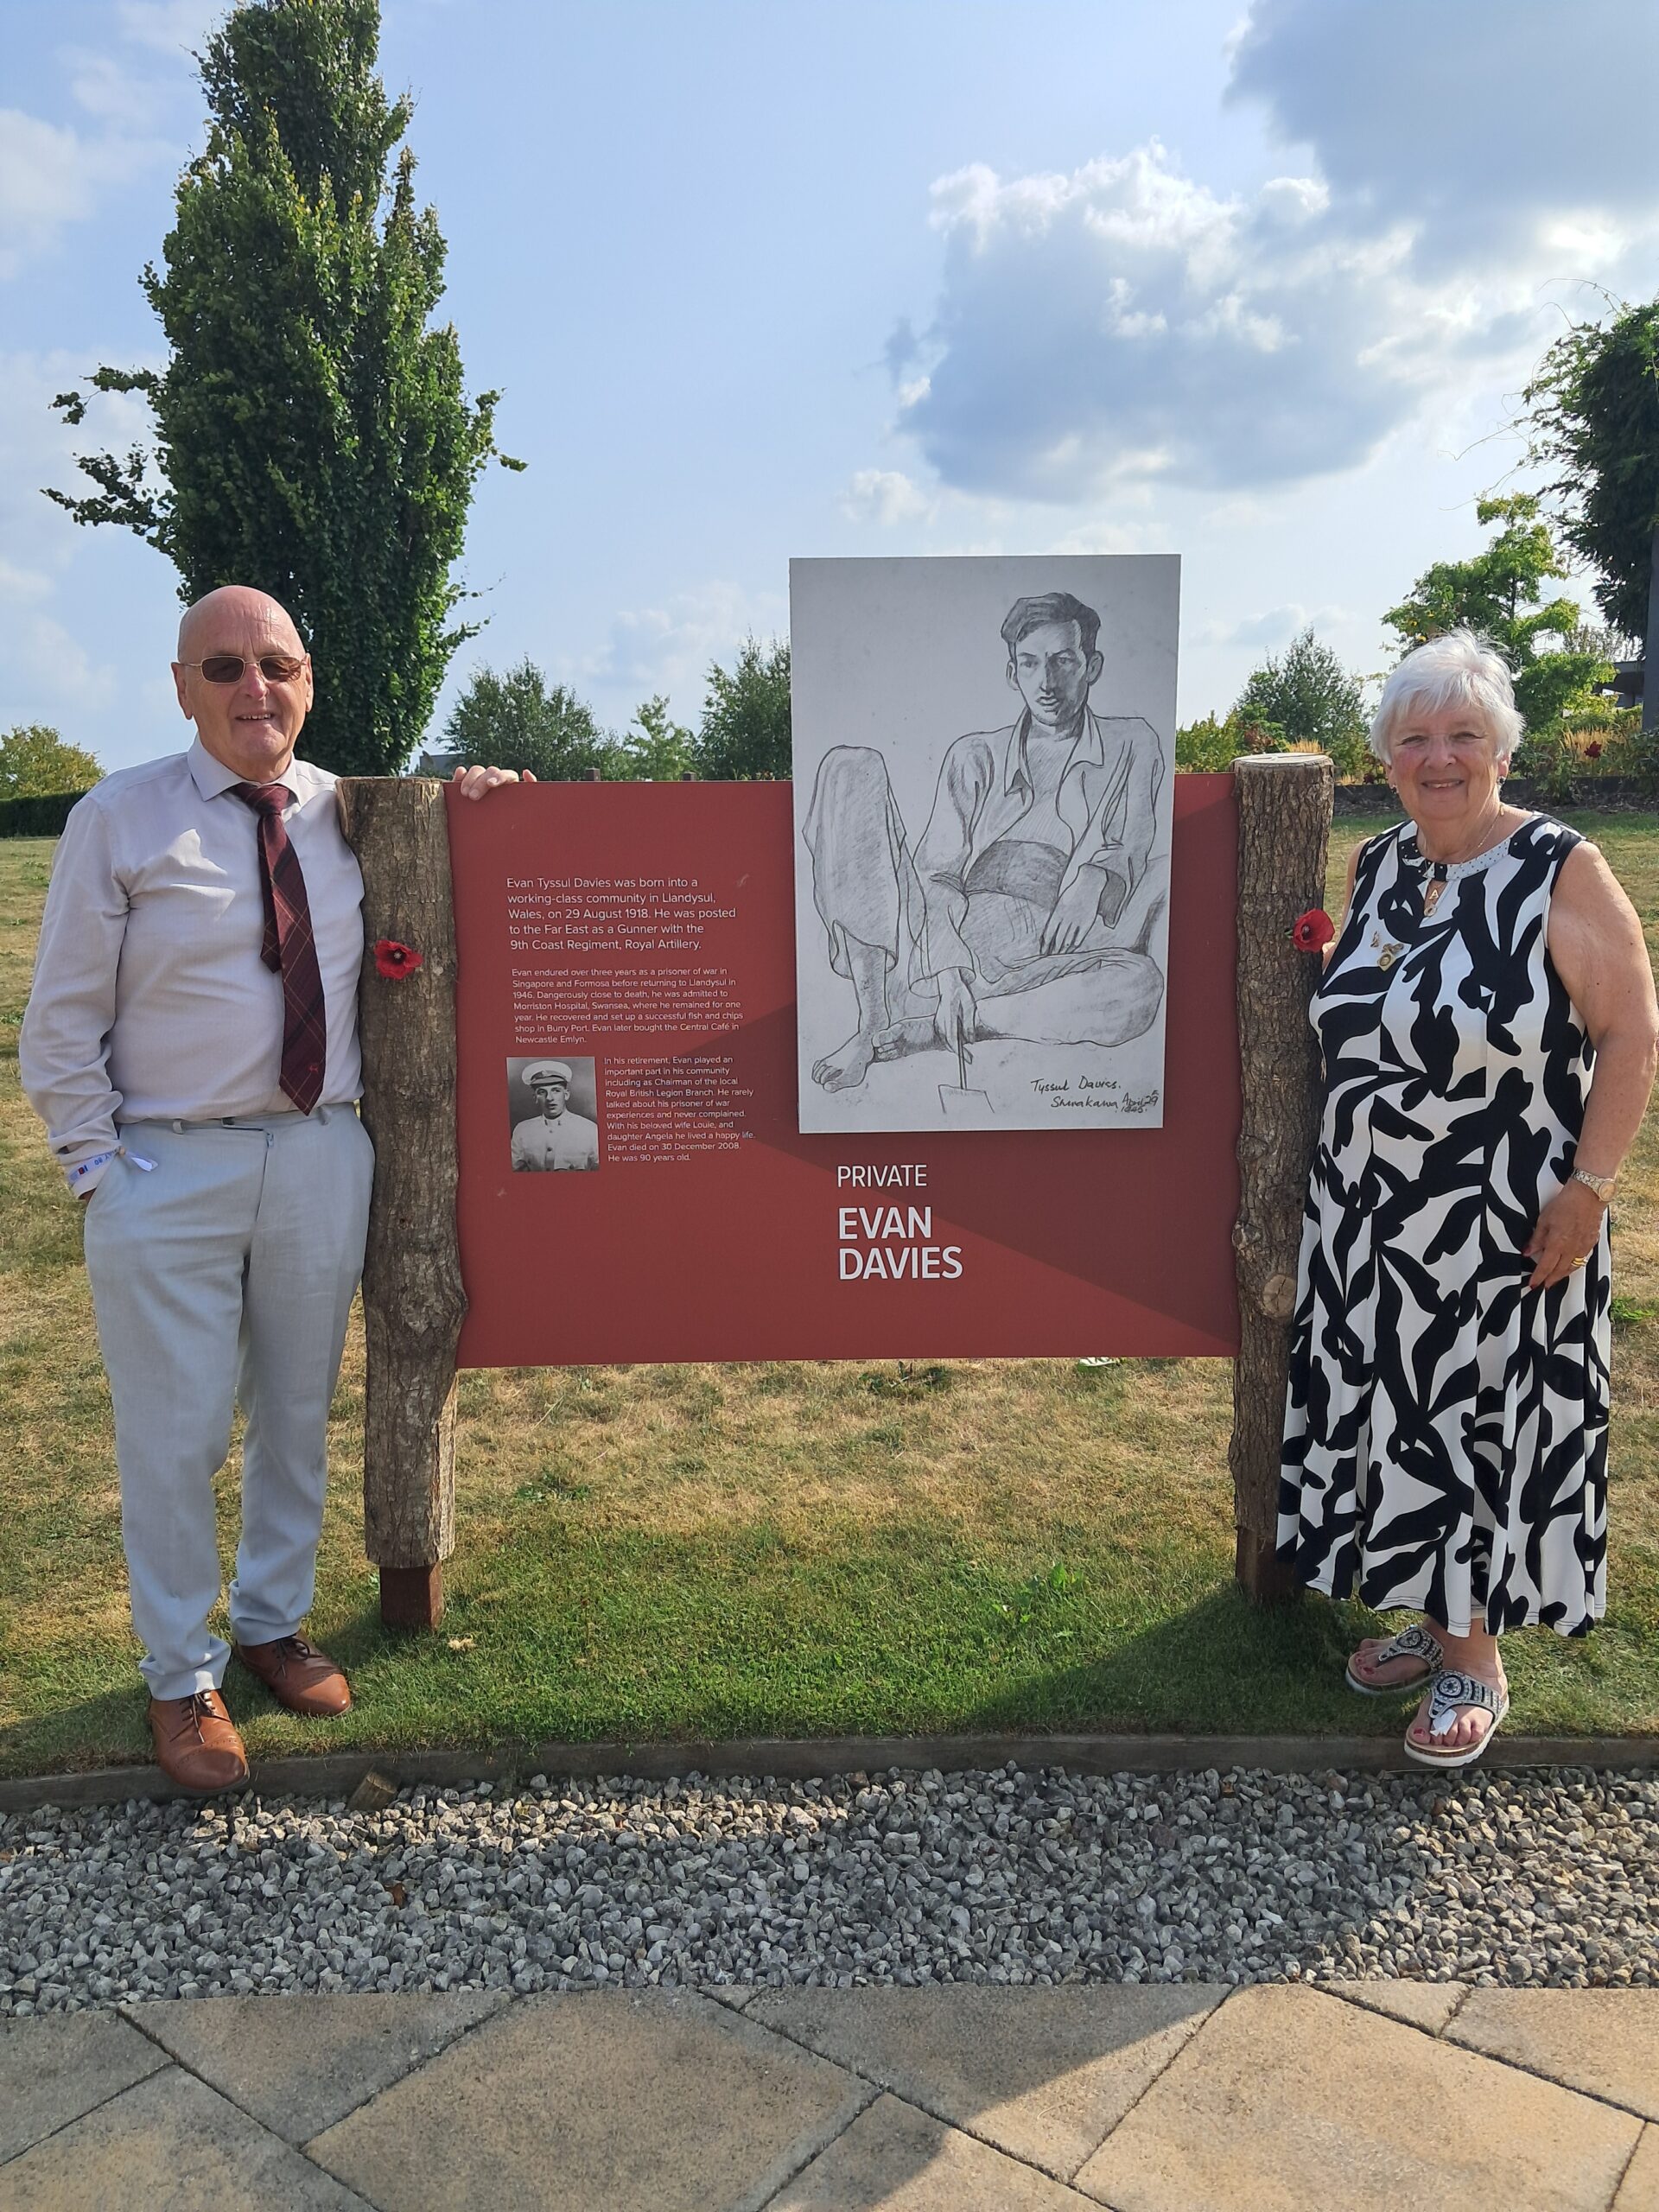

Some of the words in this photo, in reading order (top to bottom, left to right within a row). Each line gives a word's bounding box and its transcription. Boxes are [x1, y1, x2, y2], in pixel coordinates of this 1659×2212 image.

[507, 878, 534, 888] Evan
[537, 878, 570, 890] Tyssul
[574, 878, 611, 887] Davies
[639, 877, 664, 887] born
[668, 878, 688, 887] into
[507, 893, 583, 906] working-class
[587, 893, 646, 906] community
[650, 893, 659, 903] in
[663, 893, 716, 905] Llandysul,
[508, 909, 544, 920] Wales,
[566, 909, 580, 918] 29
[583, 909, 622, 921] August
[626, 908, 651, 918] 1918.
[655, 908, 671, 918] He
[699, 908, 736, 920] posted
[509, 925, 520, 935] to
[524, 925, 542, 934] the
[544, 925, 563, 934] Far
[565, 924, 589, 934] East
[617, 924, 658, 934] Gunner
[661, 924, 683, 934] with
[687, 924, 704, 933] the
[511, 940, 529, 950] 9th
[532, 940, 564, 950] Coast
[567, 939, 622, 951] Regiment,
[626, 939, 655, 951] Royal
[658, 939, 702, 951] Artillery.
[658, 968, 690, 976] prisoner
[512, 980, 554, 989] Singapore
[640, 979, 677, 988] returning
[690, 979, 727, 988] Llandysul
[537, 991, 588, 1001] Dangerously
[624, 990, 650, 999] death,
[645, 1012, 687, 1020] successful
[722, 1012, 744, 1020] chips
[515, 1025, 536, 1033] shop
[547, 1024, 569, 1033] Burry
[634, 1024, 663, 1033] bought
[694, 1056, 721, 1065] played
[605, 1068, 643, 1077] important
[645, 1068, 661, 1077] part
[686, 1067, 730, 1076] community
[605, 1079, 641, 1088] including
[1031, 1078, 1070, 1094] Tyssul
[606, 1090, 627, 1099] Royal
[657, 1090, 683, 1098] Legion
[732, 1089, 753, 1097] rarely
[671, 1100, 703, 1109] prisoner
[607, 1111, 654, 1120] experiences
[698, 1110, 747, 1119] complained.
[607, 1134, 643, 1142] daughter
[645, 1133, 673, 1141] Angela
[715, 1132, 741, 1141] happy
[837, 1165, 927, 1188] PRIVATE
[839, 1207, 931, 1240] EVAN
[839, 1246, 963, 1280] DAVIES
